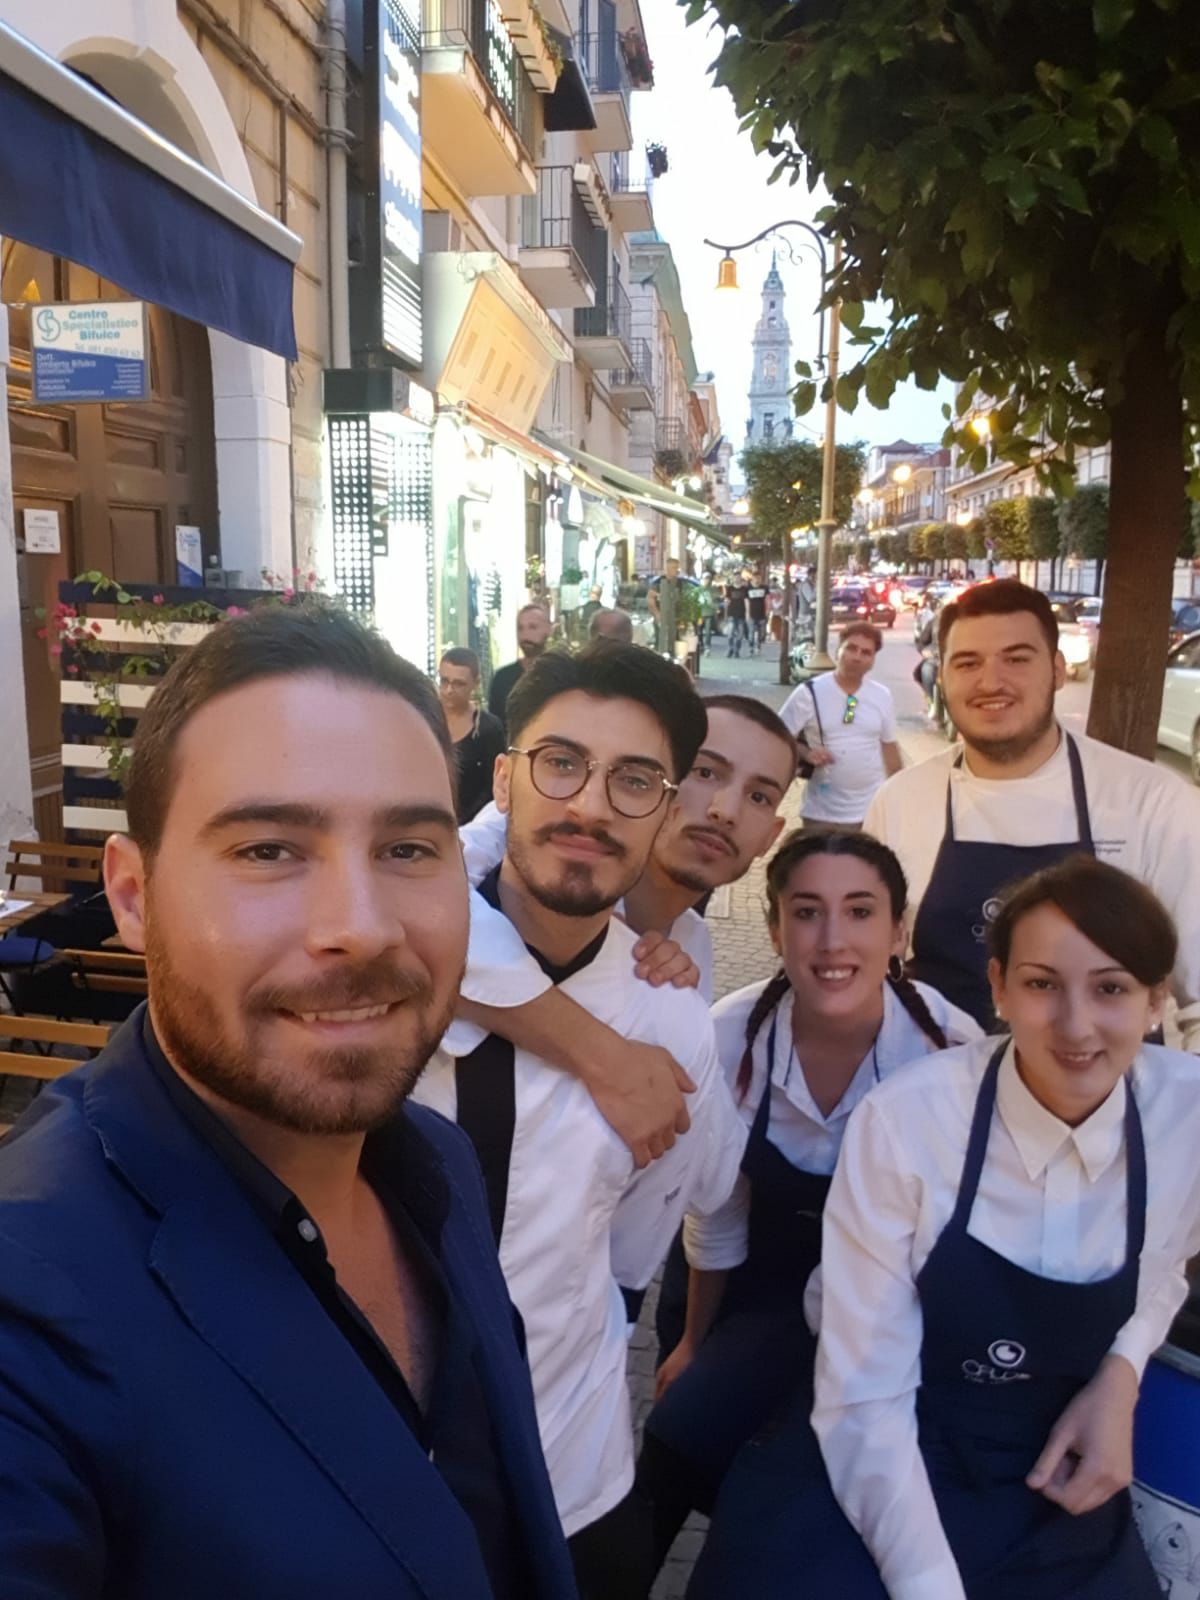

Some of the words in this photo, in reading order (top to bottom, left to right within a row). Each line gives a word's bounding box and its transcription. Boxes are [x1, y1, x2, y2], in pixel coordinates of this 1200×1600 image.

[68, 309, 108, 320] Centro
[62, 319, 138, 332] Specialistico
[79, 330, 121, 340] Bifulco
